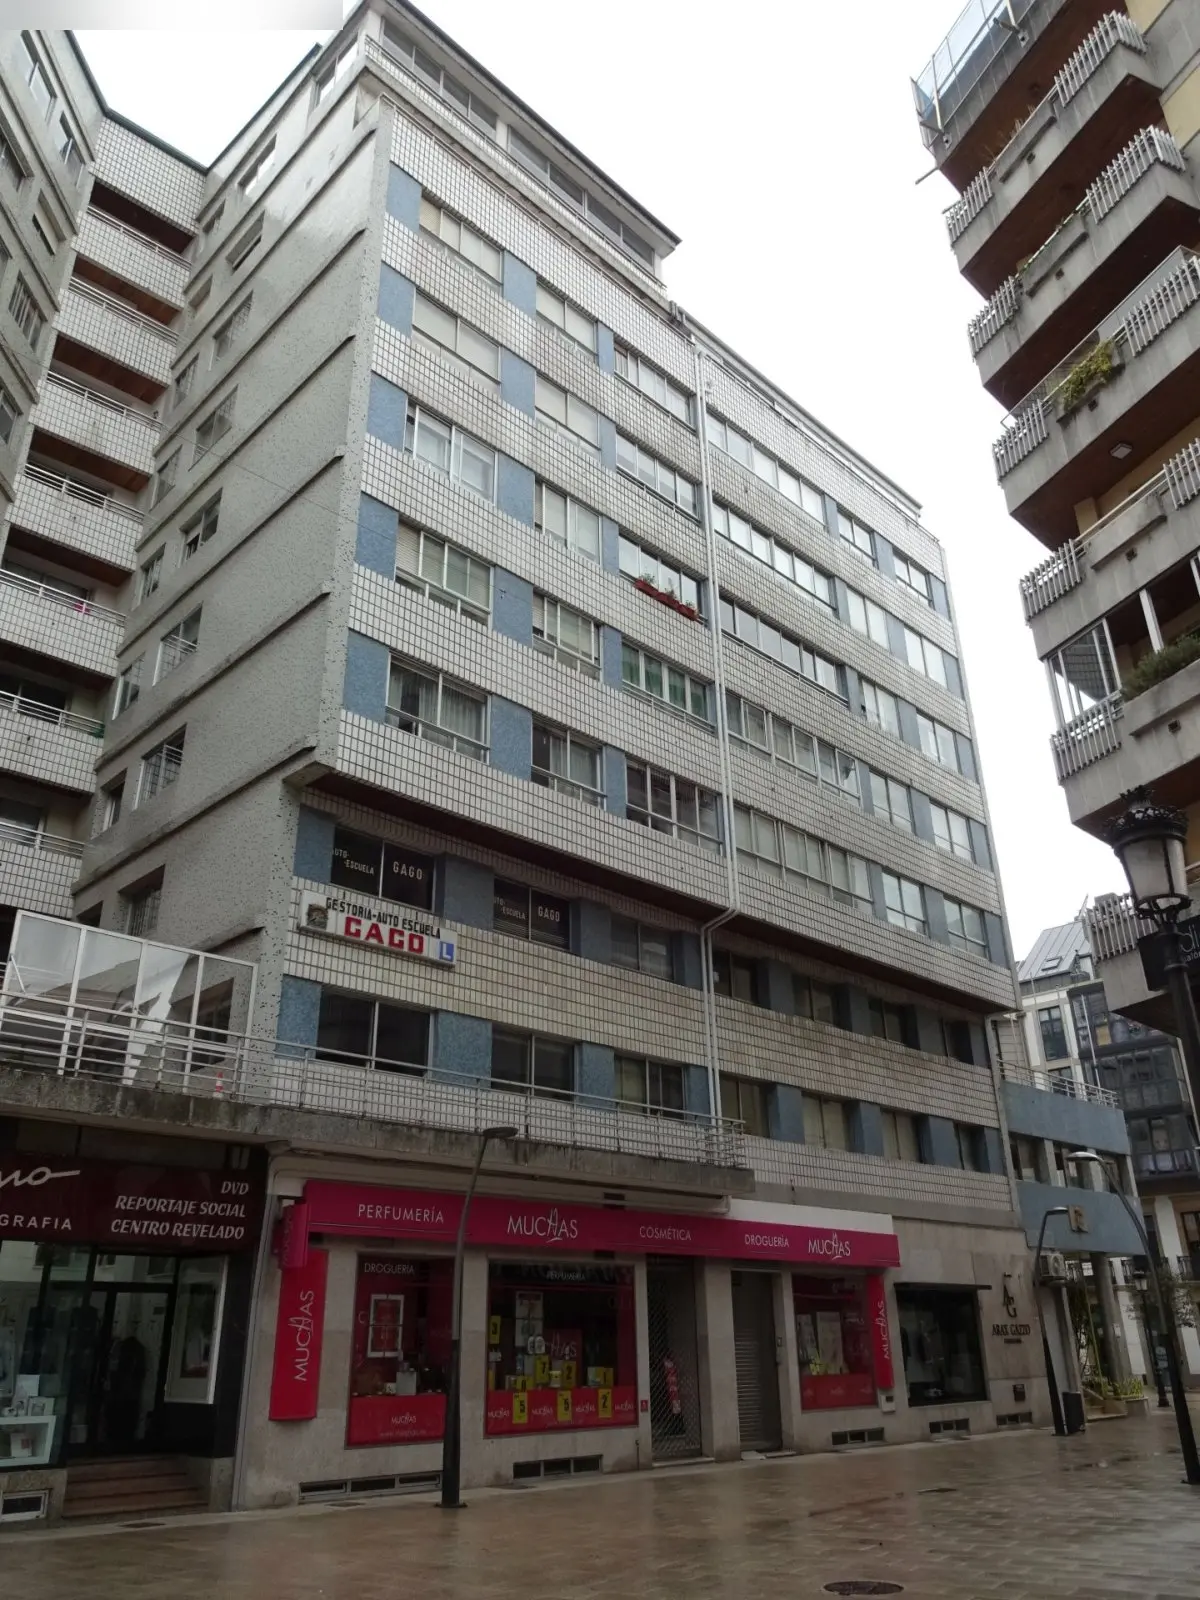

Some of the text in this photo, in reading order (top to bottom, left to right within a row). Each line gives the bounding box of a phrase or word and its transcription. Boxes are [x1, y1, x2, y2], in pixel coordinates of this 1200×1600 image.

[393, 860, 423, 880] GAGO
[538, 906, 560, 922] GAGO
[344, 916, 424, 954] GAGO
[402, 917, 441, 940] ESCUELA
[220, 1180, 249, 1196] DVD
[115, 1195, 247, 1218] REPORTAJE SOCIAL
[358, 1203, 444, 1224] PERFUMERÍA
[0, 1213, 72, 1230] GRAFIA
[111, 1218, 245, 1240] CENTRO REVELADO
[507, 1208, 578, 1243] MUCHAS
[639, 1224, 692, 1241] COSMÉTICA
[744, 1233, 790, 1248] DROGUERÍA
[808, 1232, 850, 1260] MUCHAS
[288, 1290, 314, 1382] MUCHAS
